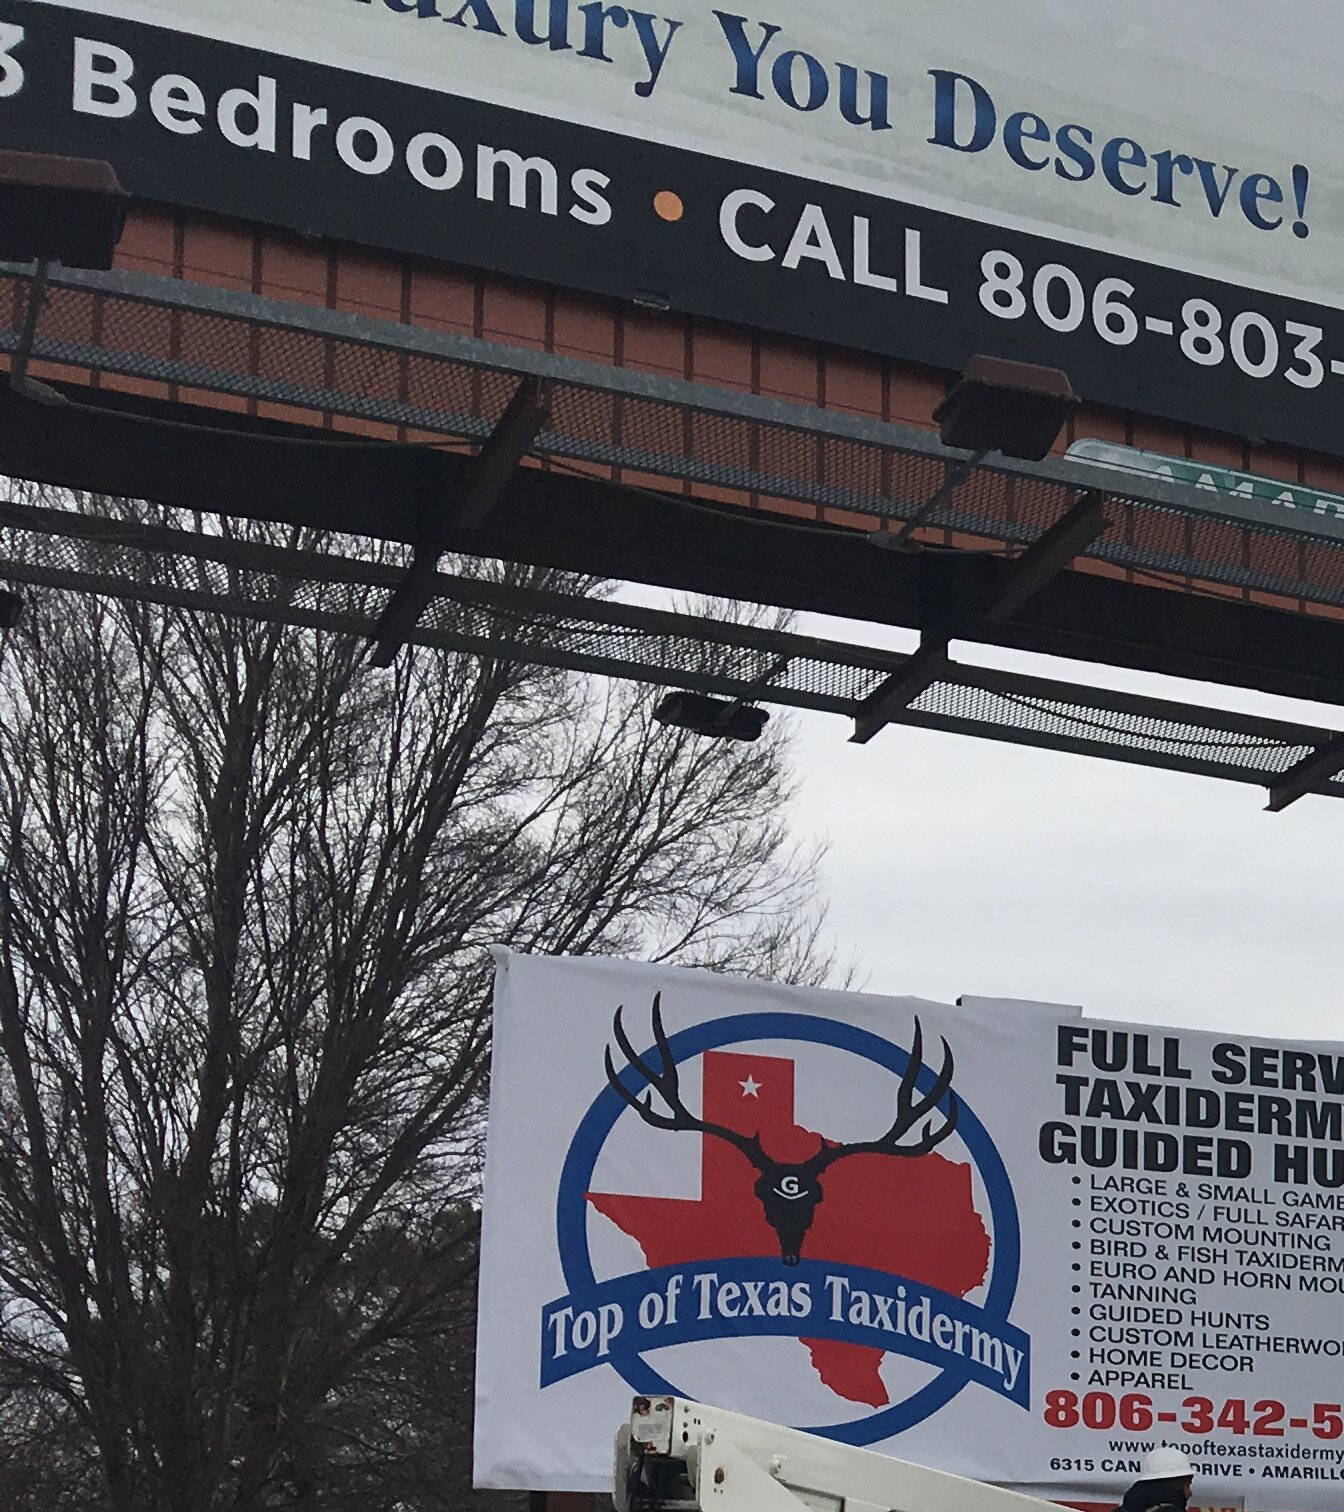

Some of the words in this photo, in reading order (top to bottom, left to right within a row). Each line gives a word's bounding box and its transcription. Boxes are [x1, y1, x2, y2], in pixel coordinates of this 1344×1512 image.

[711, 9, 892, 131] You
[926, 69, 1310, 239] Deserve!
[72, 36, 614, 226] Bedrooms
[719, 188, 948, 304] CALL
[1057, 1025, 1192, 1080] FULL
[1038, 1121, 1252, 1179] GUIDED
[780, 1176, 799, 1194] G
[1090, 1174, 1167, 1196] LARGE
[1175, 1182, 1191, 1198] &
[1197, 1182, 1270, 1205] SMALL
[1090, 1195, 1190, 1219] EXOTICS
[1213, 1204, 1274, 1226] FULL
[1089, 1217, 1195, 1241] CUSTOM
[1203, 1226, 1331, 1252] MOUNTING
[1090, 1239, 1147, 1260] BIRD
[1155, 1245, 1170, 1261] &
[1177, 1246, 1228, 1266] FISH
[1090, 1261, 1157, 1282] EURO
[1163, 1265, 1216, 1285] AND
[1223, 1271, 1292, 1290] HORN
[1089, 1282, 1198, 1305] TANNING
[549, 1306, 624, 1360] Top
[639, 1275, 683, 1330] of
[693, 1273, 812, 1320] Texas
[825, 1276, 1025, 1390] Taxidermy
[1089, 1303, 1184, 1326] GUIDED
[1190, 1311, 1270, 1331] HUNTS
[1089, 1325, 1195, 1348] CUSTOM
[1089, 1347, 1164, 1369] HOME
[1170, 1352, 1255, 1373] DECOR
[1088, 1369, 1194, 1391] APPAREL
[1050, 1457, 1096, 1472] 6315
